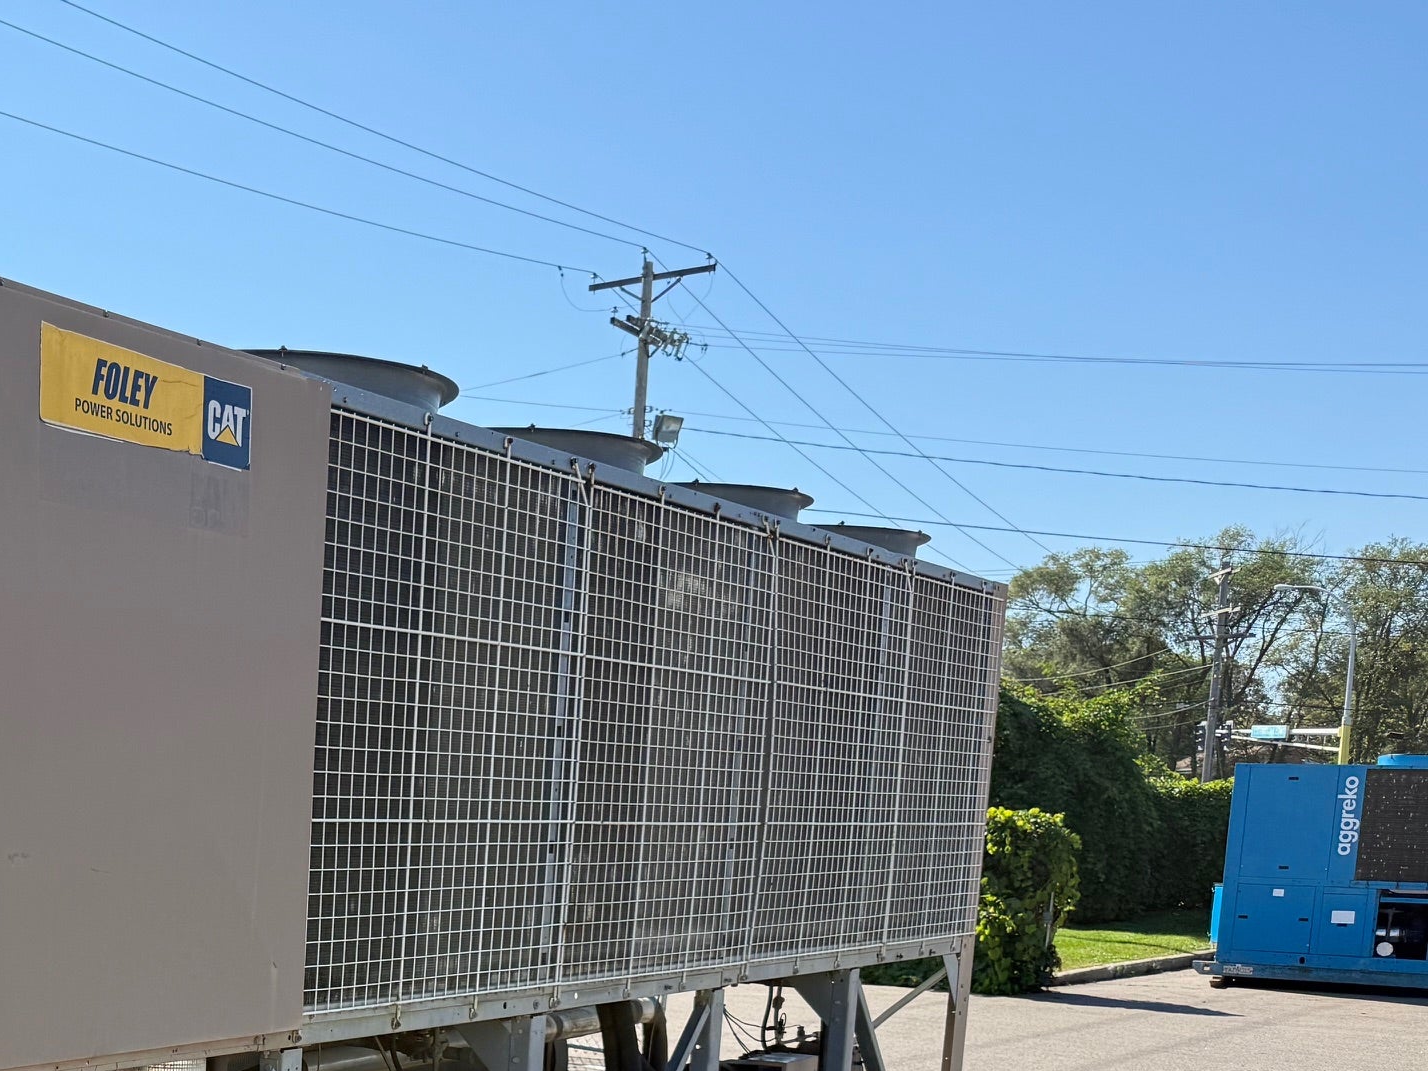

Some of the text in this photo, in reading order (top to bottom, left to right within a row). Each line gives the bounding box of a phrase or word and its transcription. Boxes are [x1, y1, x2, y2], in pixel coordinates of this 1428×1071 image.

[91, 358, 158, 410] FOLEY
[74, 397, 173, 436] POWER SOLUTIONS
[207, 399, 246, 447] CAT
[1337, 775, 1360, 856] aggreko
